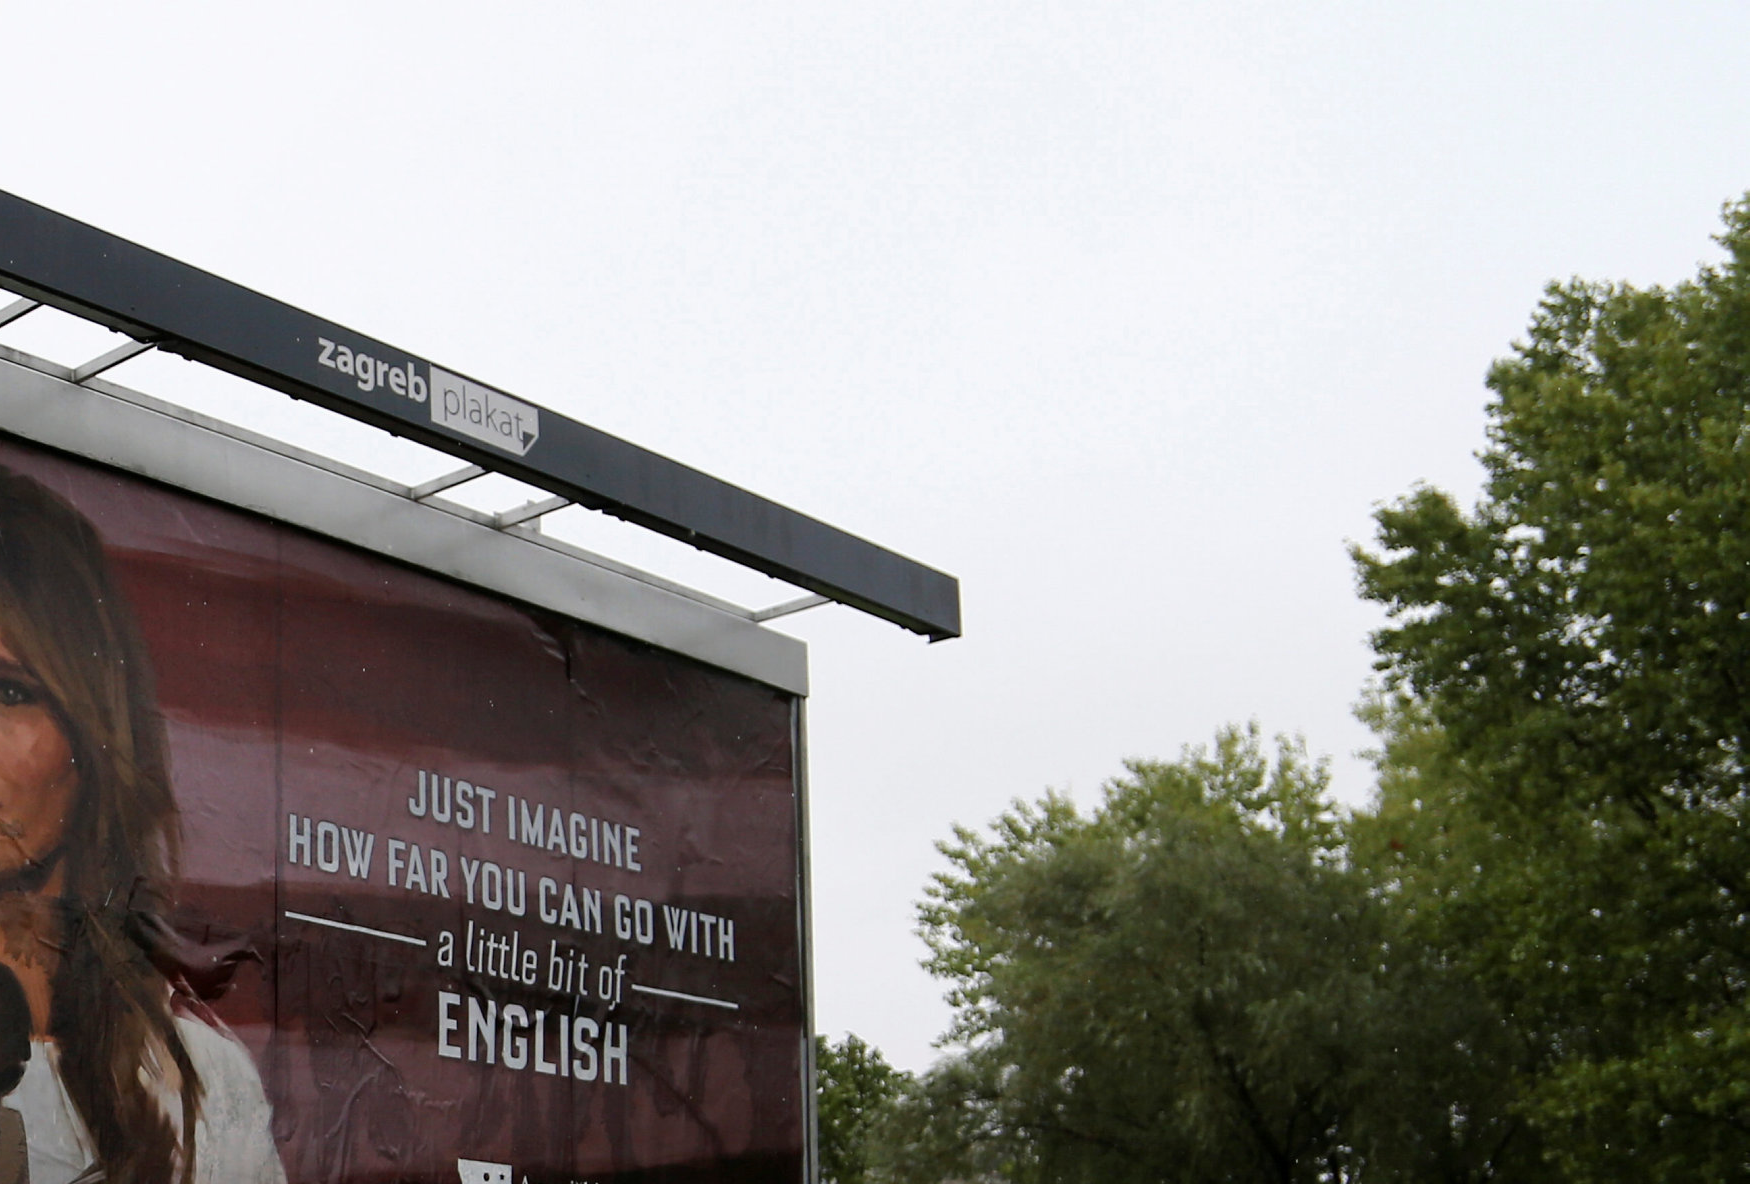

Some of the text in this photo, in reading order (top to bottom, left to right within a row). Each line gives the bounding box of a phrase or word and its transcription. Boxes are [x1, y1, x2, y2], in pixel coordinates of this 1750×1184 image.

[317, 336, 525, 443] zagreb plakat
[408, 769, 642, 873] JUST IMAGINE
[287, 813, 735, 962] HOW FAR YOU CAN GO WITH
[436, 920, 627, 1011] a little bit of
[437, 989, 628, 1086] ENGLISH
